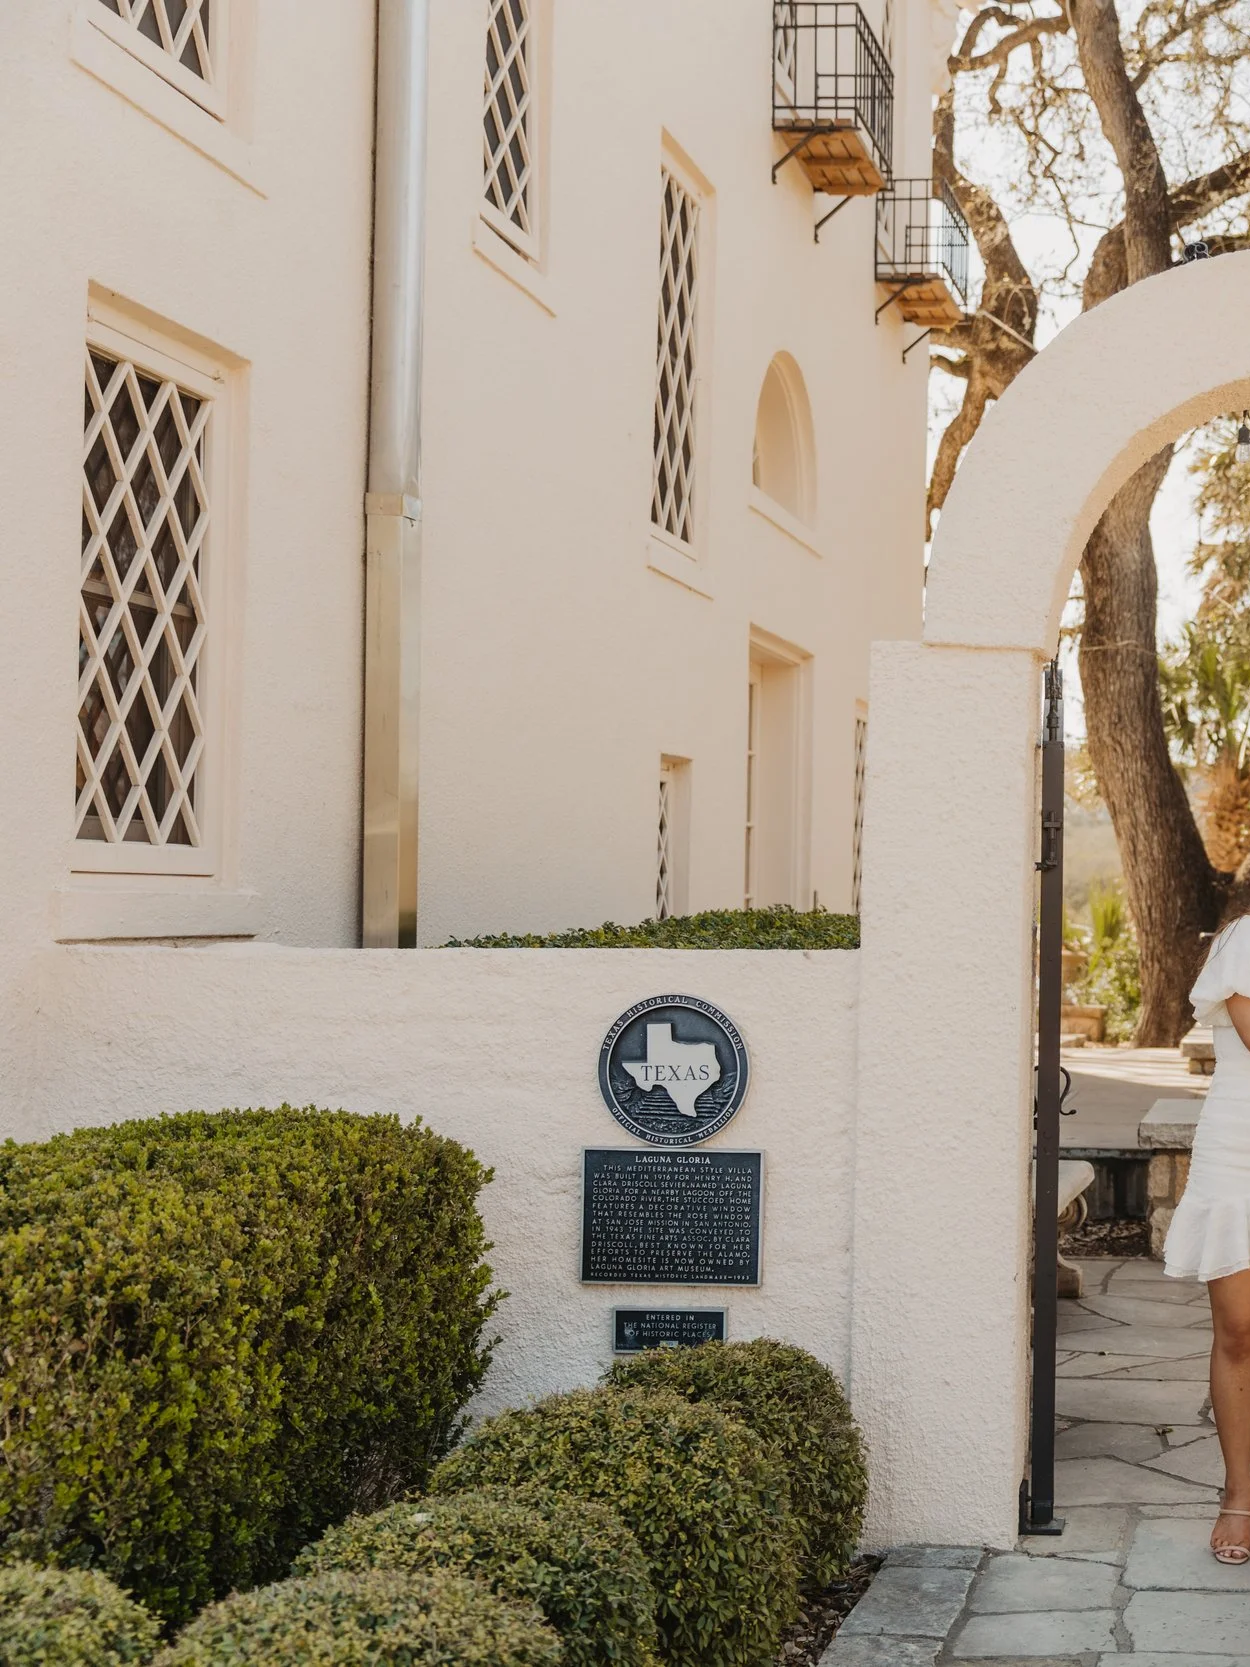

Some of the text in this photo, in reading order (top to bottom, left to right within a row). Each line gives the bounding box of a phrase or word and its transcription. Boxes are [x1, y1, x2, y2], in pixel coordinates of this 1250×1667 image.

[602, 996, 744, 1050] TEXAS HISTORICAL COMMISSION
[641, 1065, 710, 1081] TEXAS
[612, 1107, 734, 1144] OFFICIAL HISTORICAL MEDALLION
